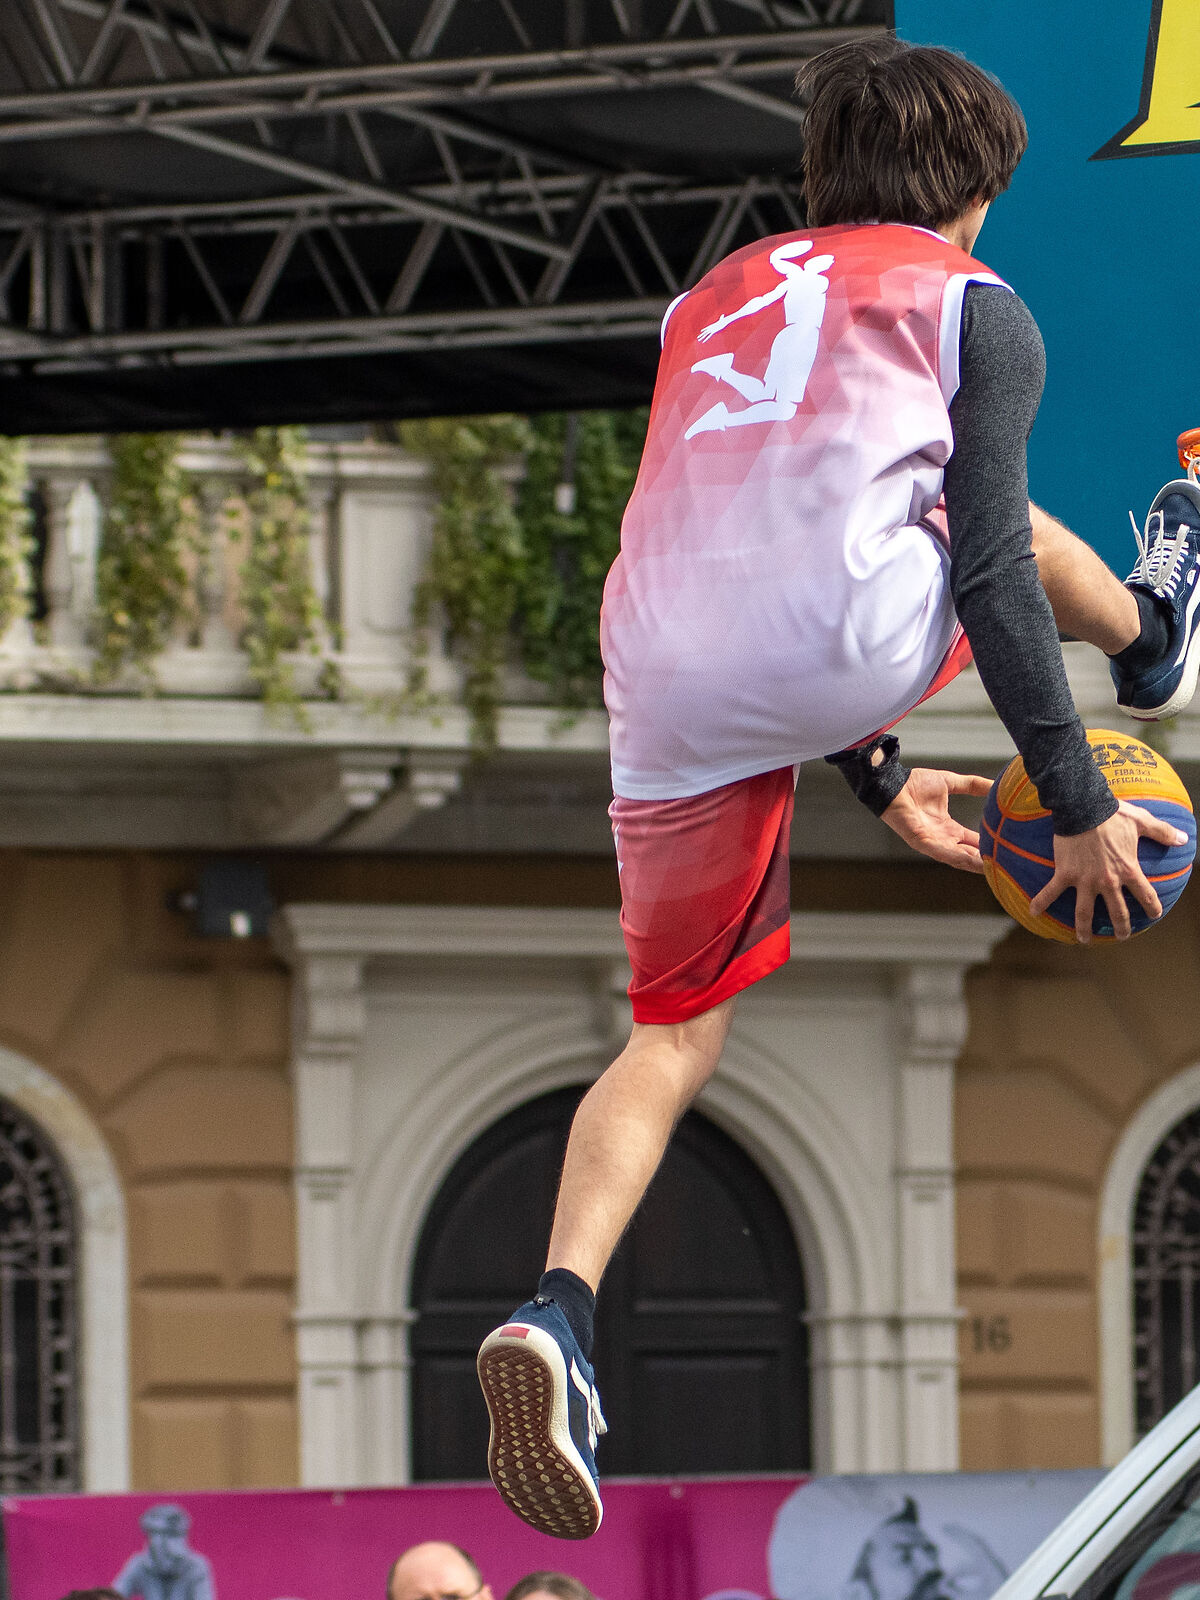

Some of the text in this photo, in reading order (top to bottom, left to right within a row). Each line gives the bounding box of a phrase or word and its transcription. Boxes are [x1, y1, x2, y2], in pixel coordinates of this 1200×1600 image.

[1114, 768, 1135, 777] FIBA
[1107, 776, 1144, 786] OFFICIAL
[972, 1315, 1013, 1354] 16
